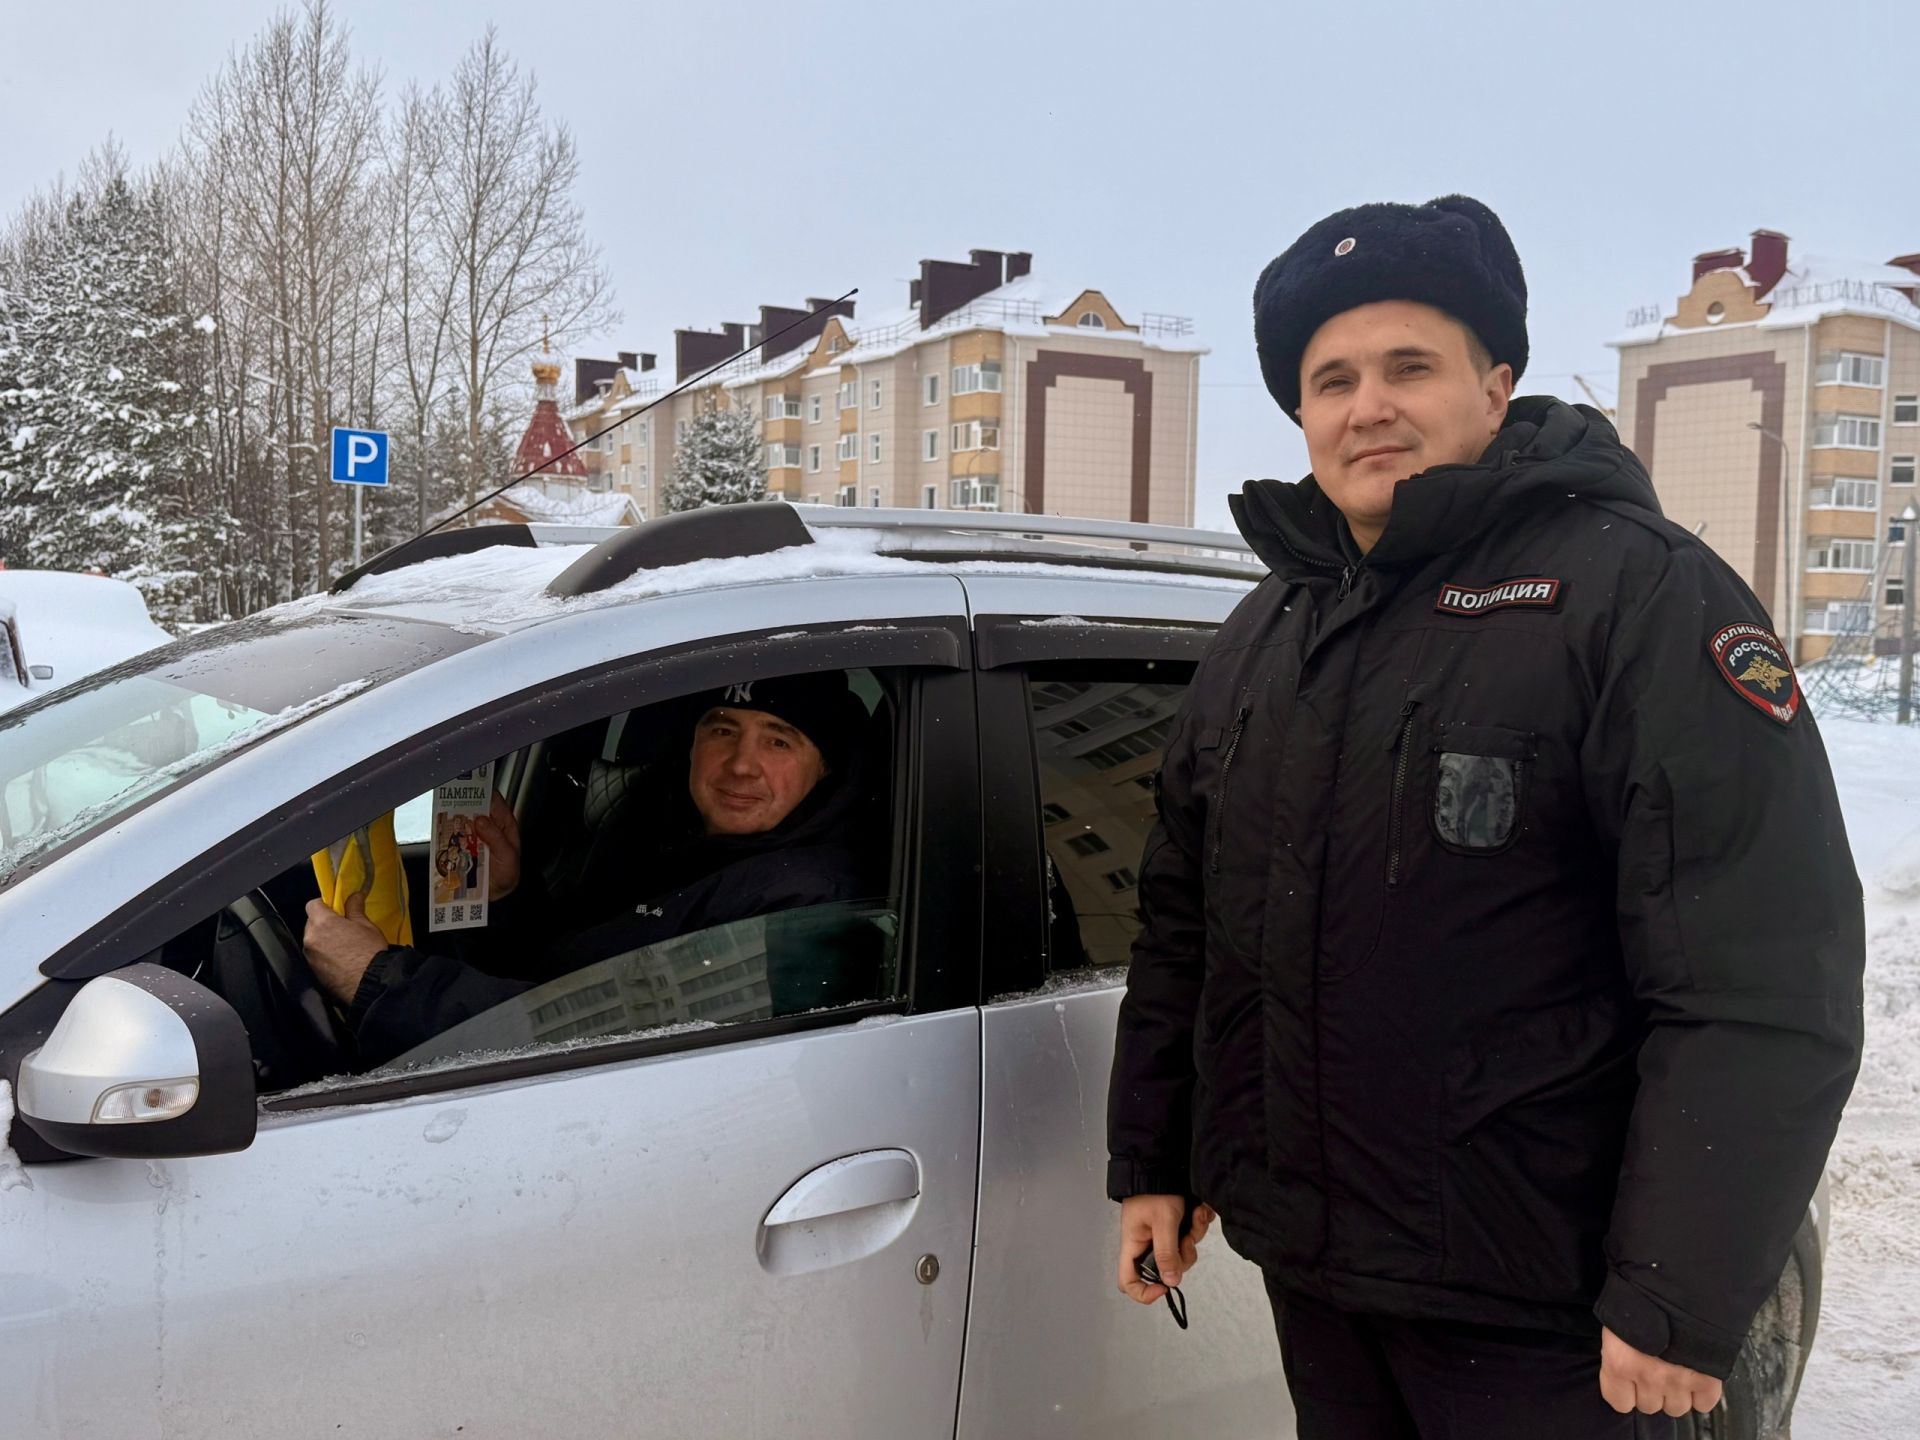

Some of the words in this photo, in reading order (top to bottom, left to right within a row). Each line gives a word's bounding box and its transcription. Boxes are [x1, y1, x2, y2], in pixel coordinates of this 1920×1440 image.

[348, 435, 378, 477] P
[1443, 583, 1552, 609] ПОЛИЦИЯ
[1714, 626, 1777, 653] ПОЛИЦИЯ
[1728, 641, 1782, 667] РОССИЯ
[1770, 703, 1795, 722] МВД
[439, 786, 486, 799] ПАМЯТКА
